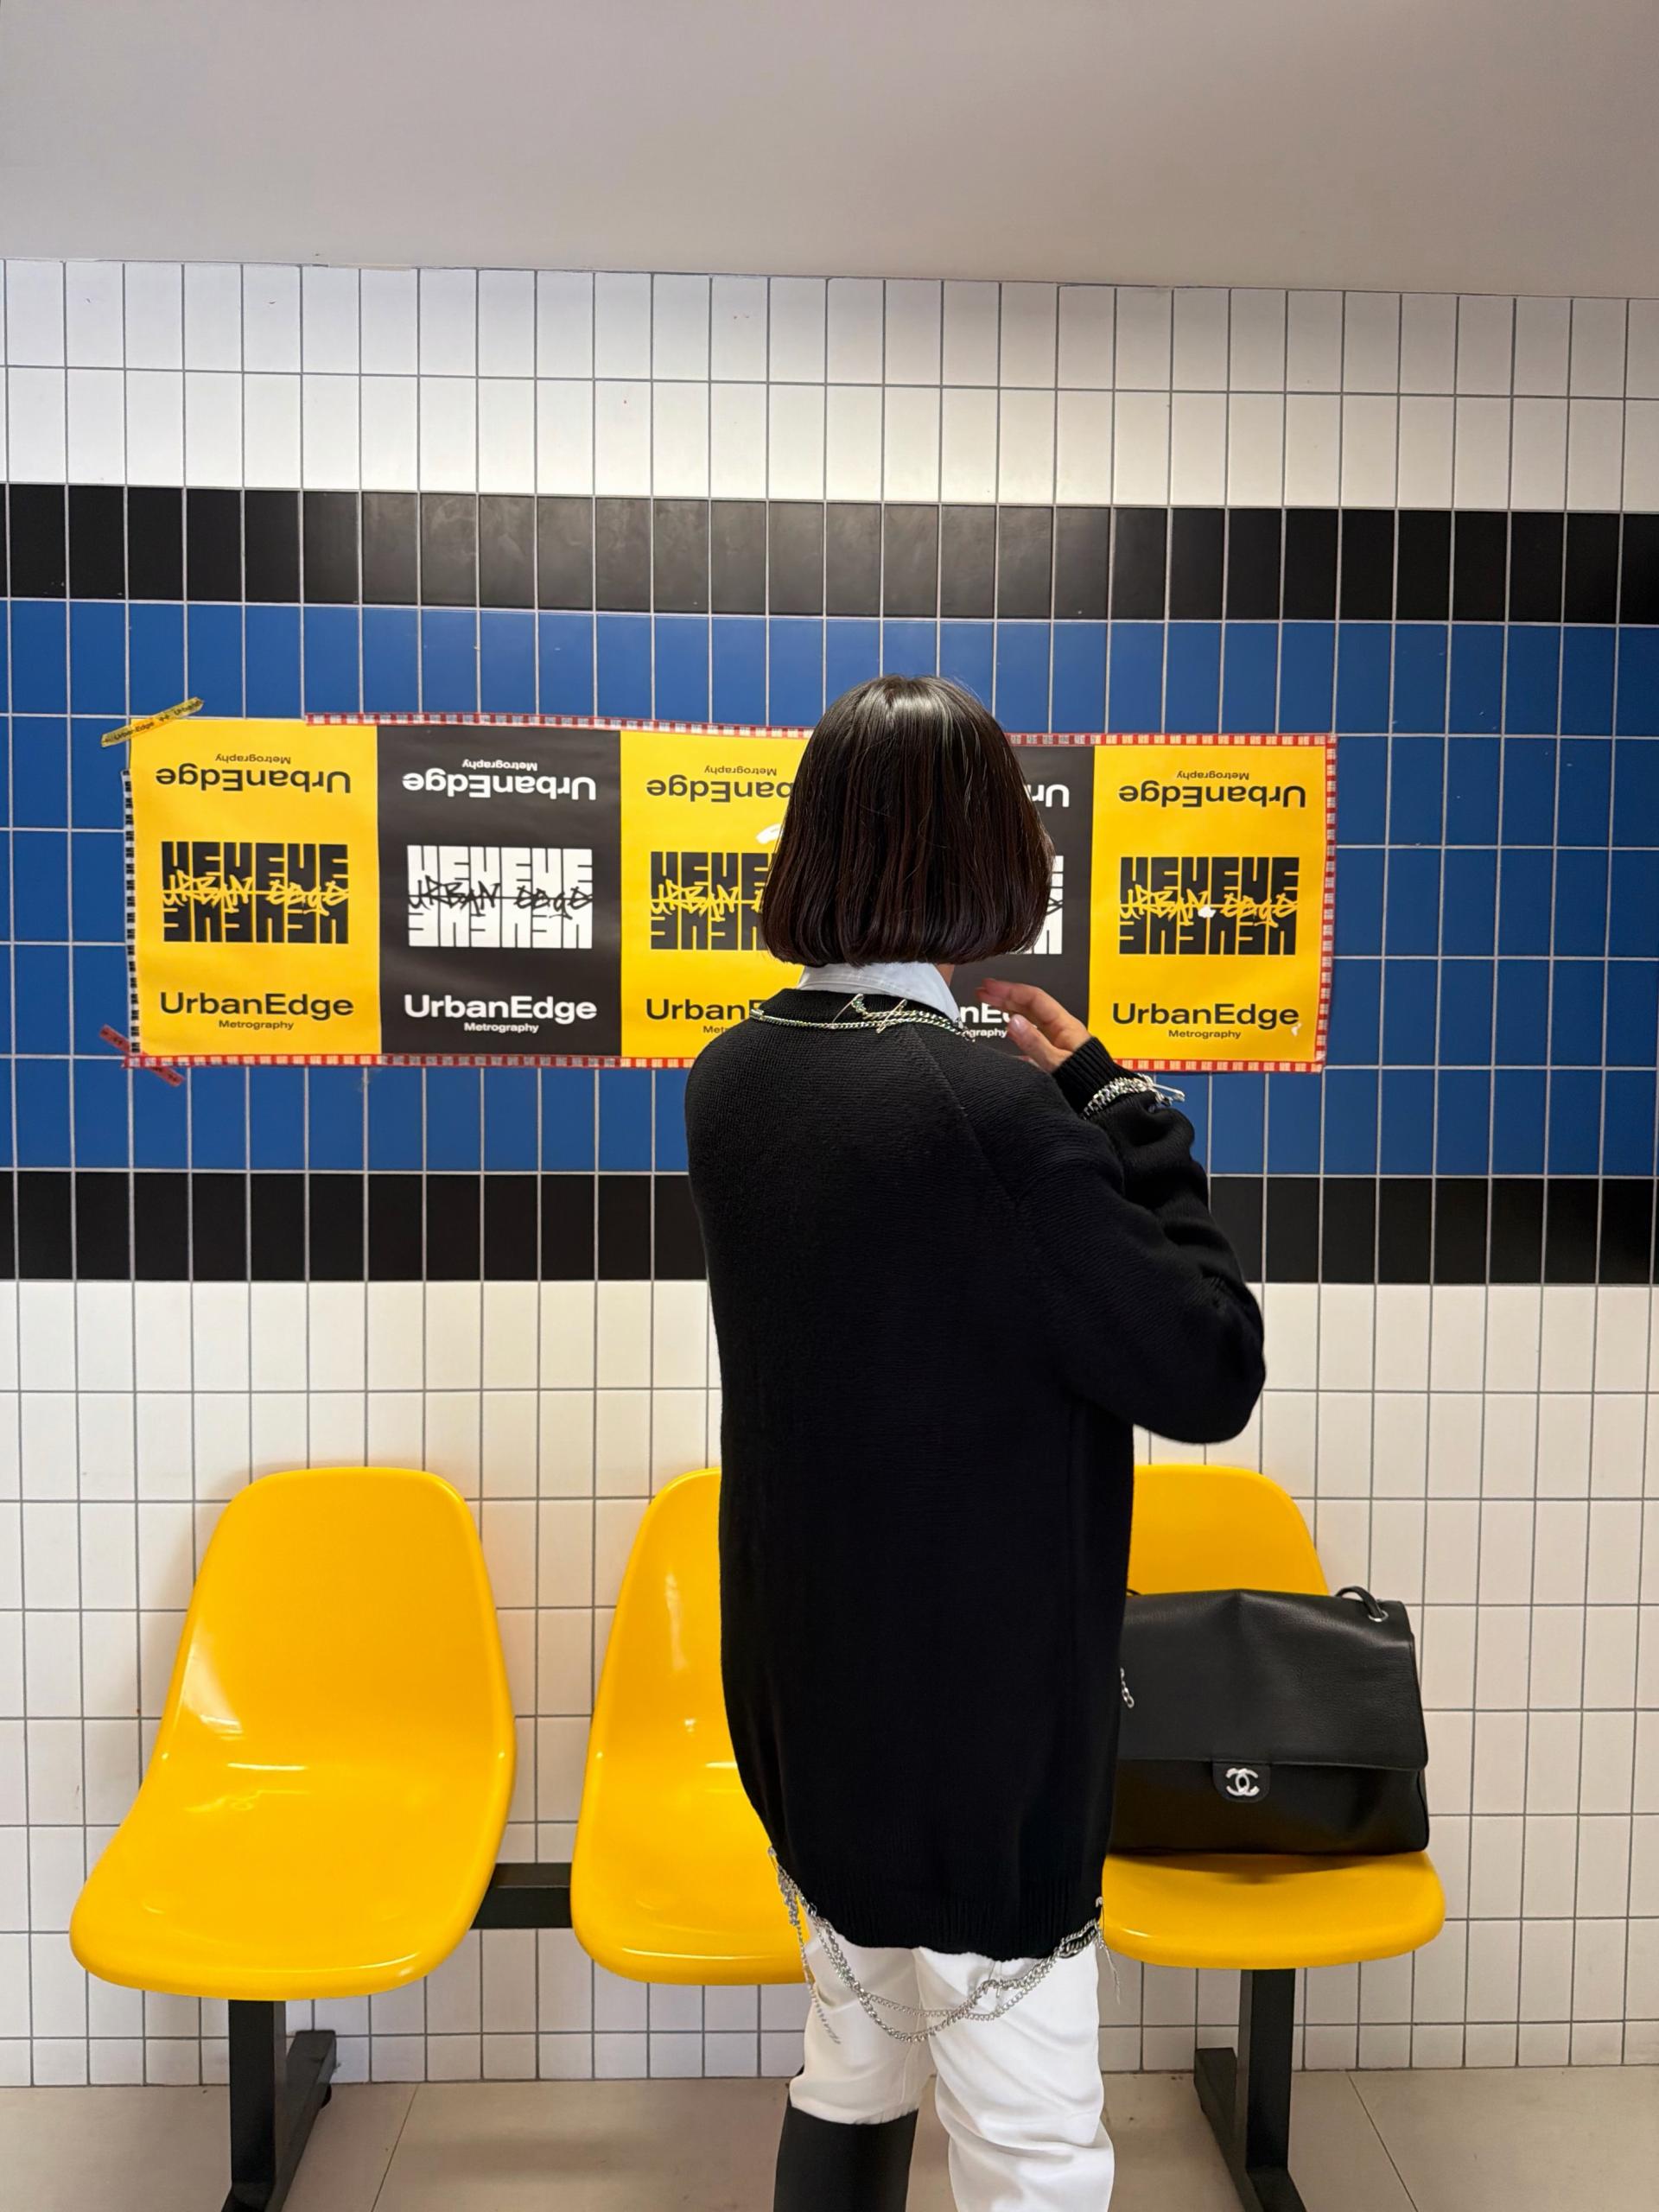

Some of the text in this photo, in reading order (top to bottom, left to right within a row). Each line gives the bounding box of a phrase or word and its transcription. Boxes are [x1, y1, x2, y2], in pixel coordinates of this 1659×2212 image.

[214, 753, 291, 765] Metrography
[461, 759, 538, 772] Metrography
[704, 765, 778, 777] Metrography
[1176, 770, 1249, 781] Metrography
[156, 769, 351, 793] UrbanEdge
[402, 772, 597, 800] UrbanEdge
[646, 774, 794, 803] banEdge
[1118, 780, 1306, 808] UrbanEdge
[160, 991, 353, 1019] UrbanEdge
[404, 994, 597, 1024] UrbanEdge
[219, 1020, 295, 1031] Metrography
[1113, 1003, 1300, 1030] UrbanEdge
[463, 1022, 539, 1033] Metrography
[1168, 1029, 1242, 1039] Metrography
